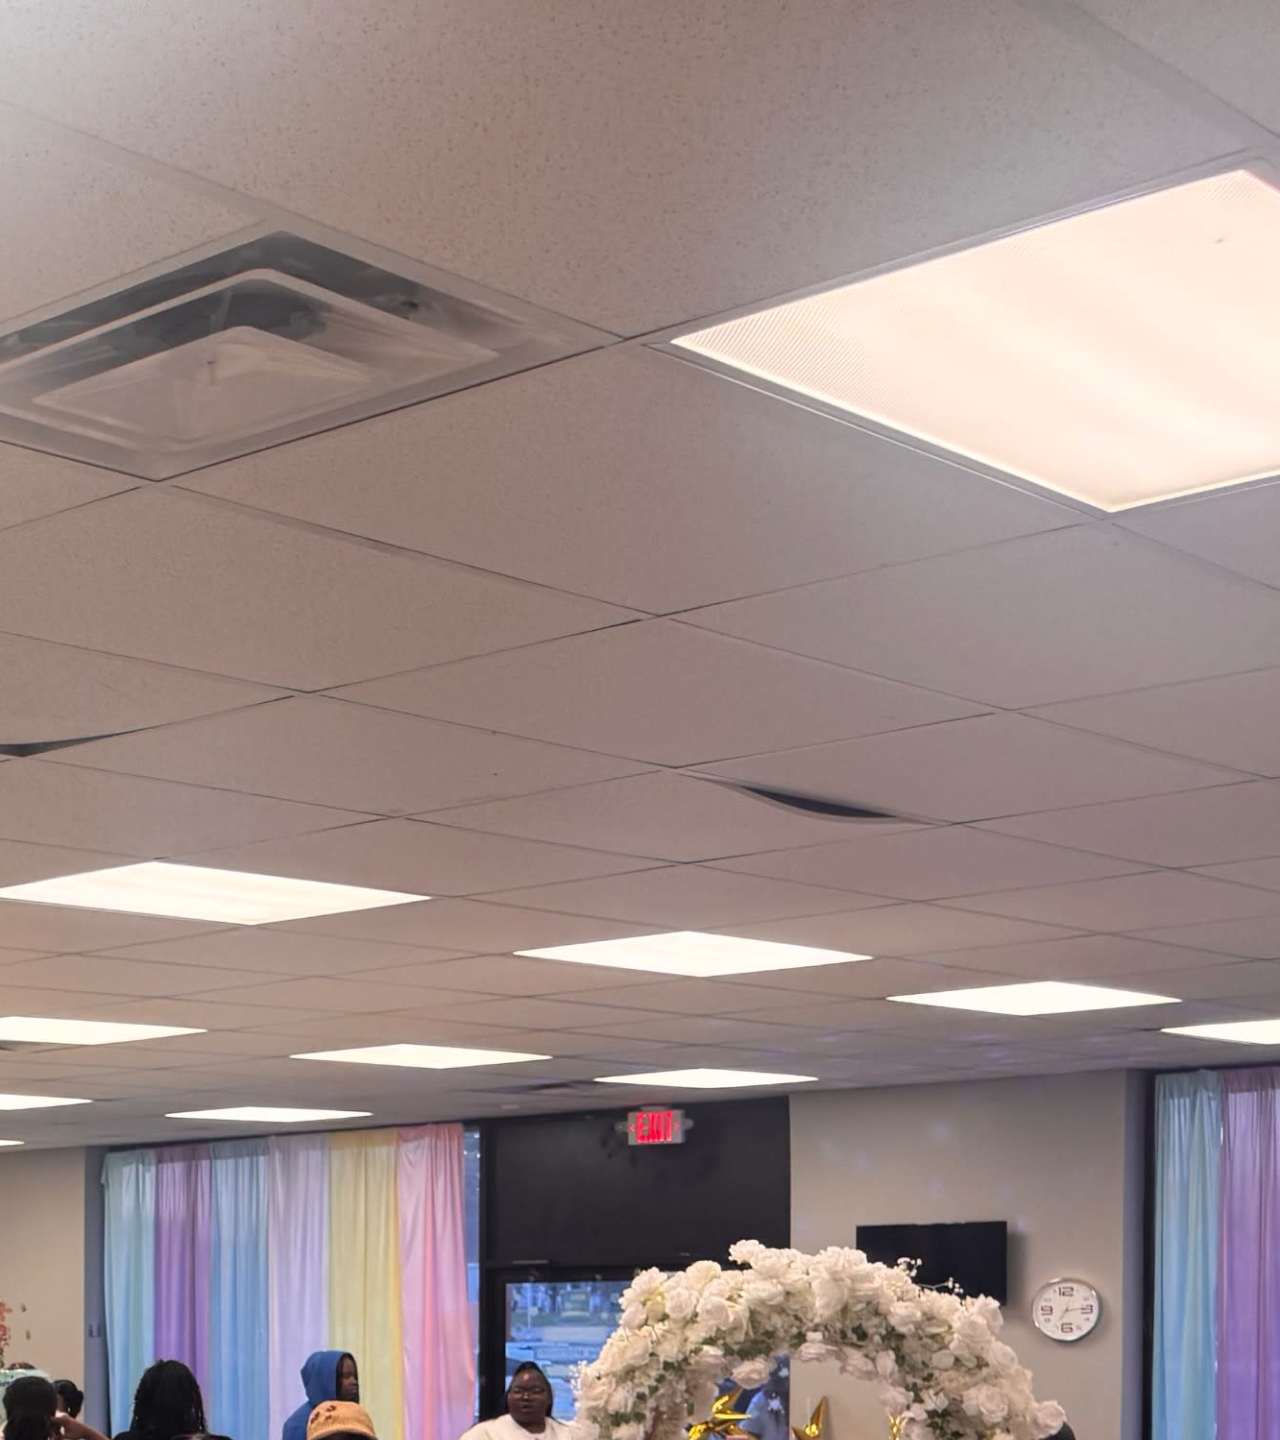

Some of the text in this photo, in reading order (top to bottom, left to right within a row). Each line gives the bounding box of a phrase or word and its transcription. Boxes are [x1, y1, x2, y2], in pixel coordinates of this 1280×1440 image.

[636, 1111, 673, 1144] EXIT
[1058, 1286, 1074, 1297] 12
[1080, 1304, 1093, 1315] 3
[1061, 1322, 1073, 1333] 6
